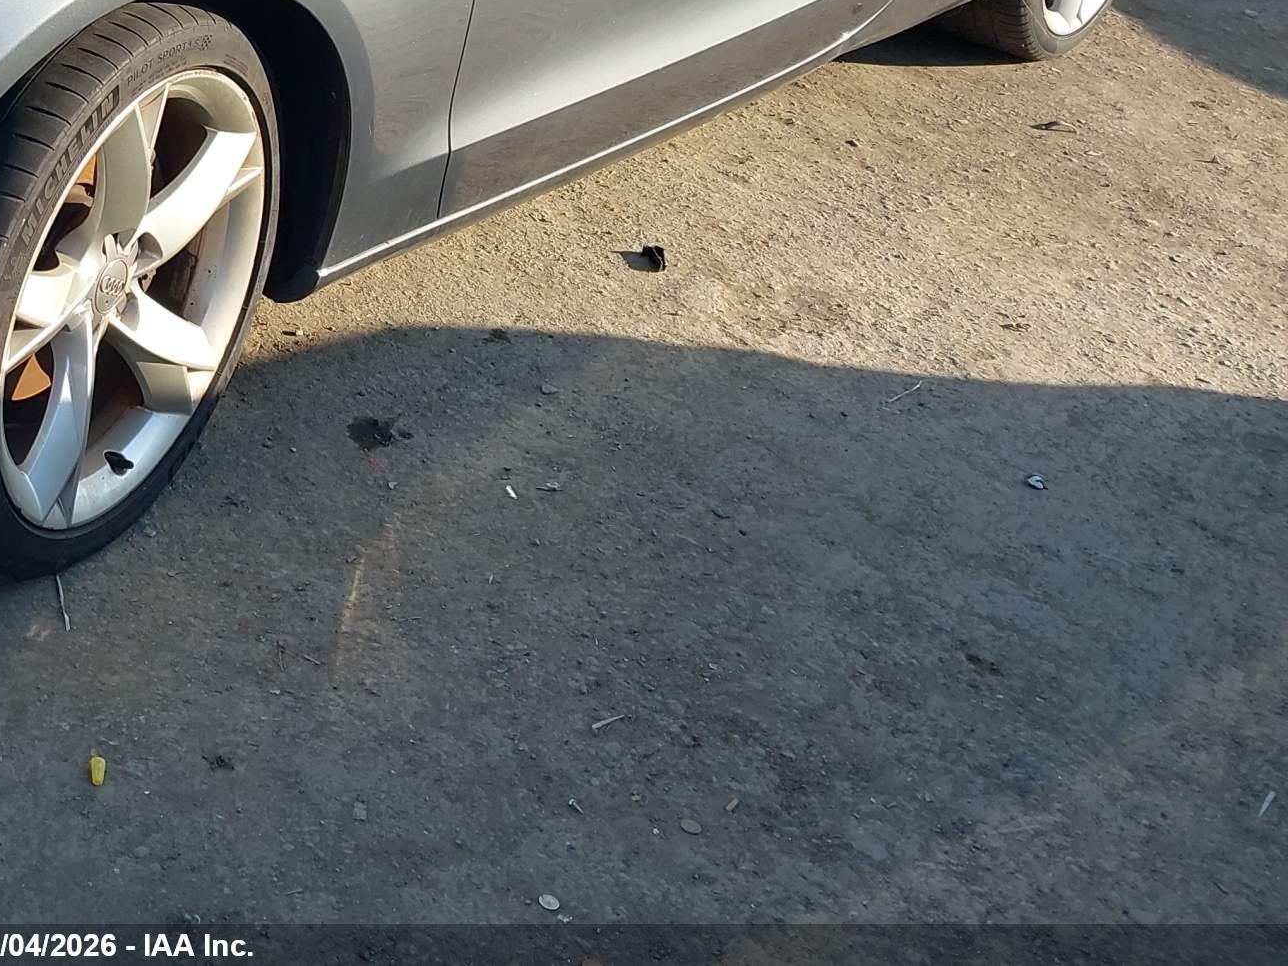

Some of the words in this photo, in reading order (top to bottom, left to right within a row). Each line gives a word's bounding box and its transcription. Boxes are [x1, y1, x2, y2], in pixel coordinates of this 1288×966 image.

[127, 57, 154, 86] PILOT
[158, 42, 187, 62] SPORT
[20, 89, 118, 247] MICHELIN
